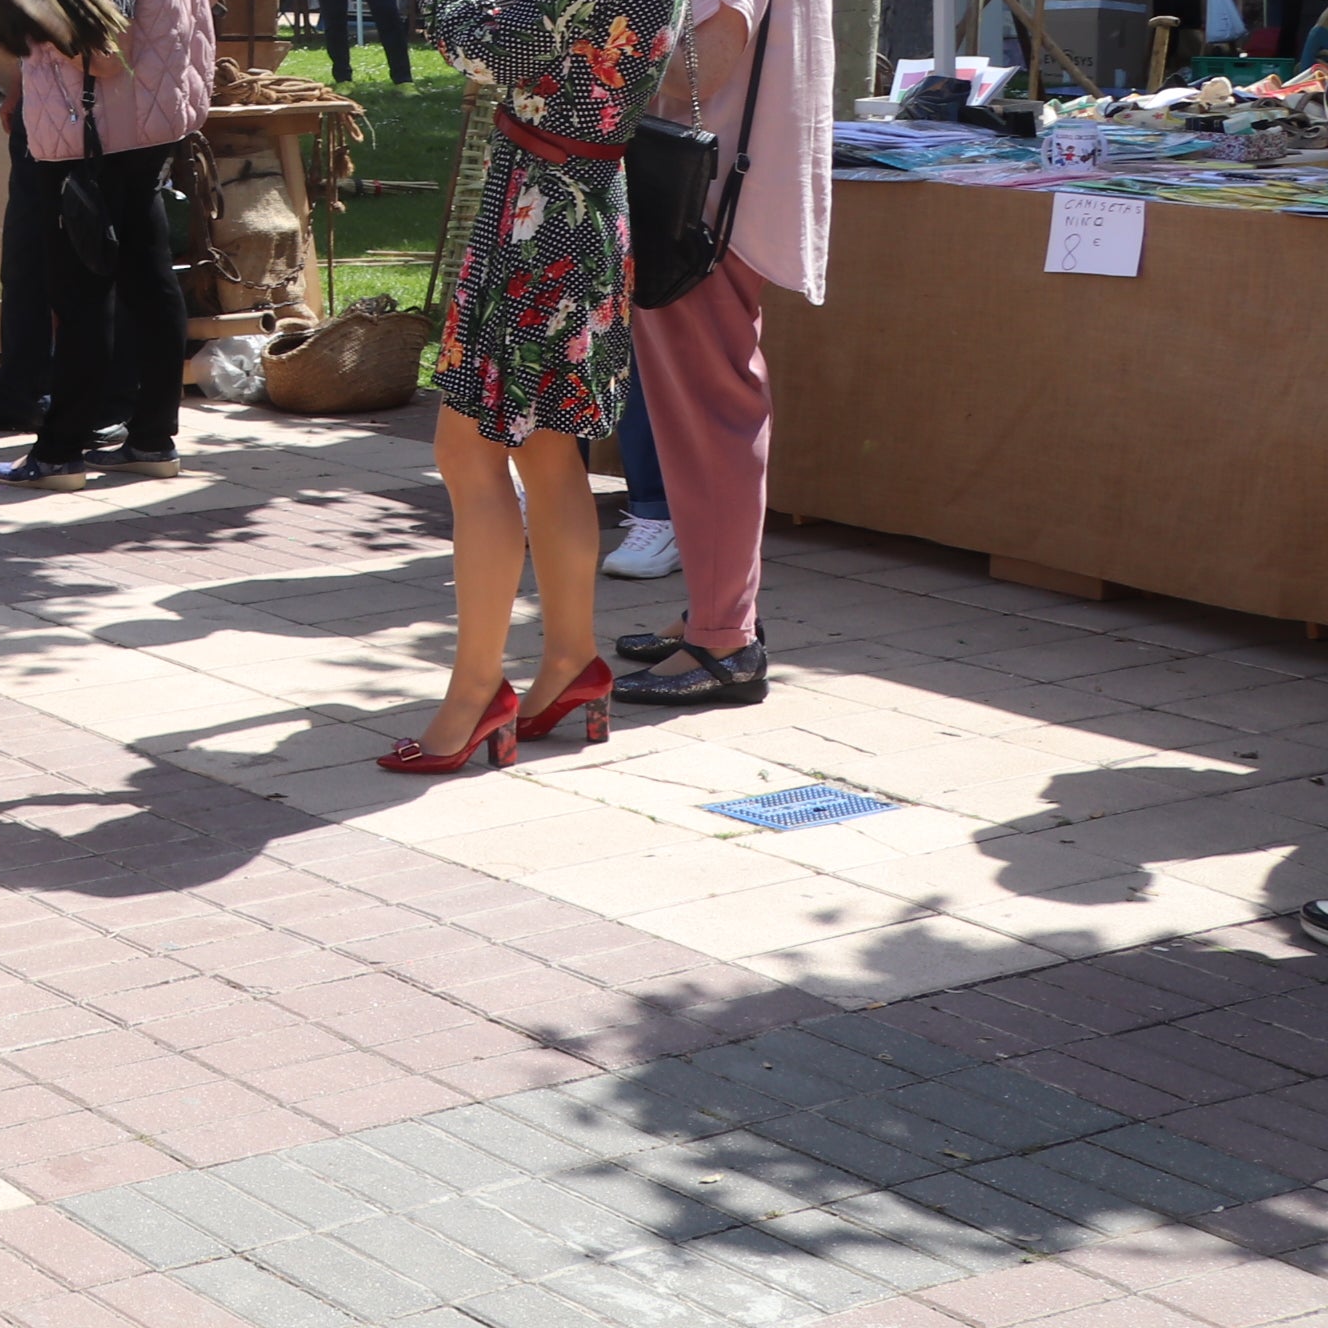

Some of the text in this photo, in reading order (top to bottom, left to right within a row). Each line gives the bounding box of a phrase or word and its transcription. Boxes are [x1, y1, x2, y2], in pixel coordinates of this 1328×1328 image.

[1064, 198, 1143, 215] CAMISETAS
[1065, 212, 1104, 227] NIÑO
[1061, 233, 1082, 271] 8
